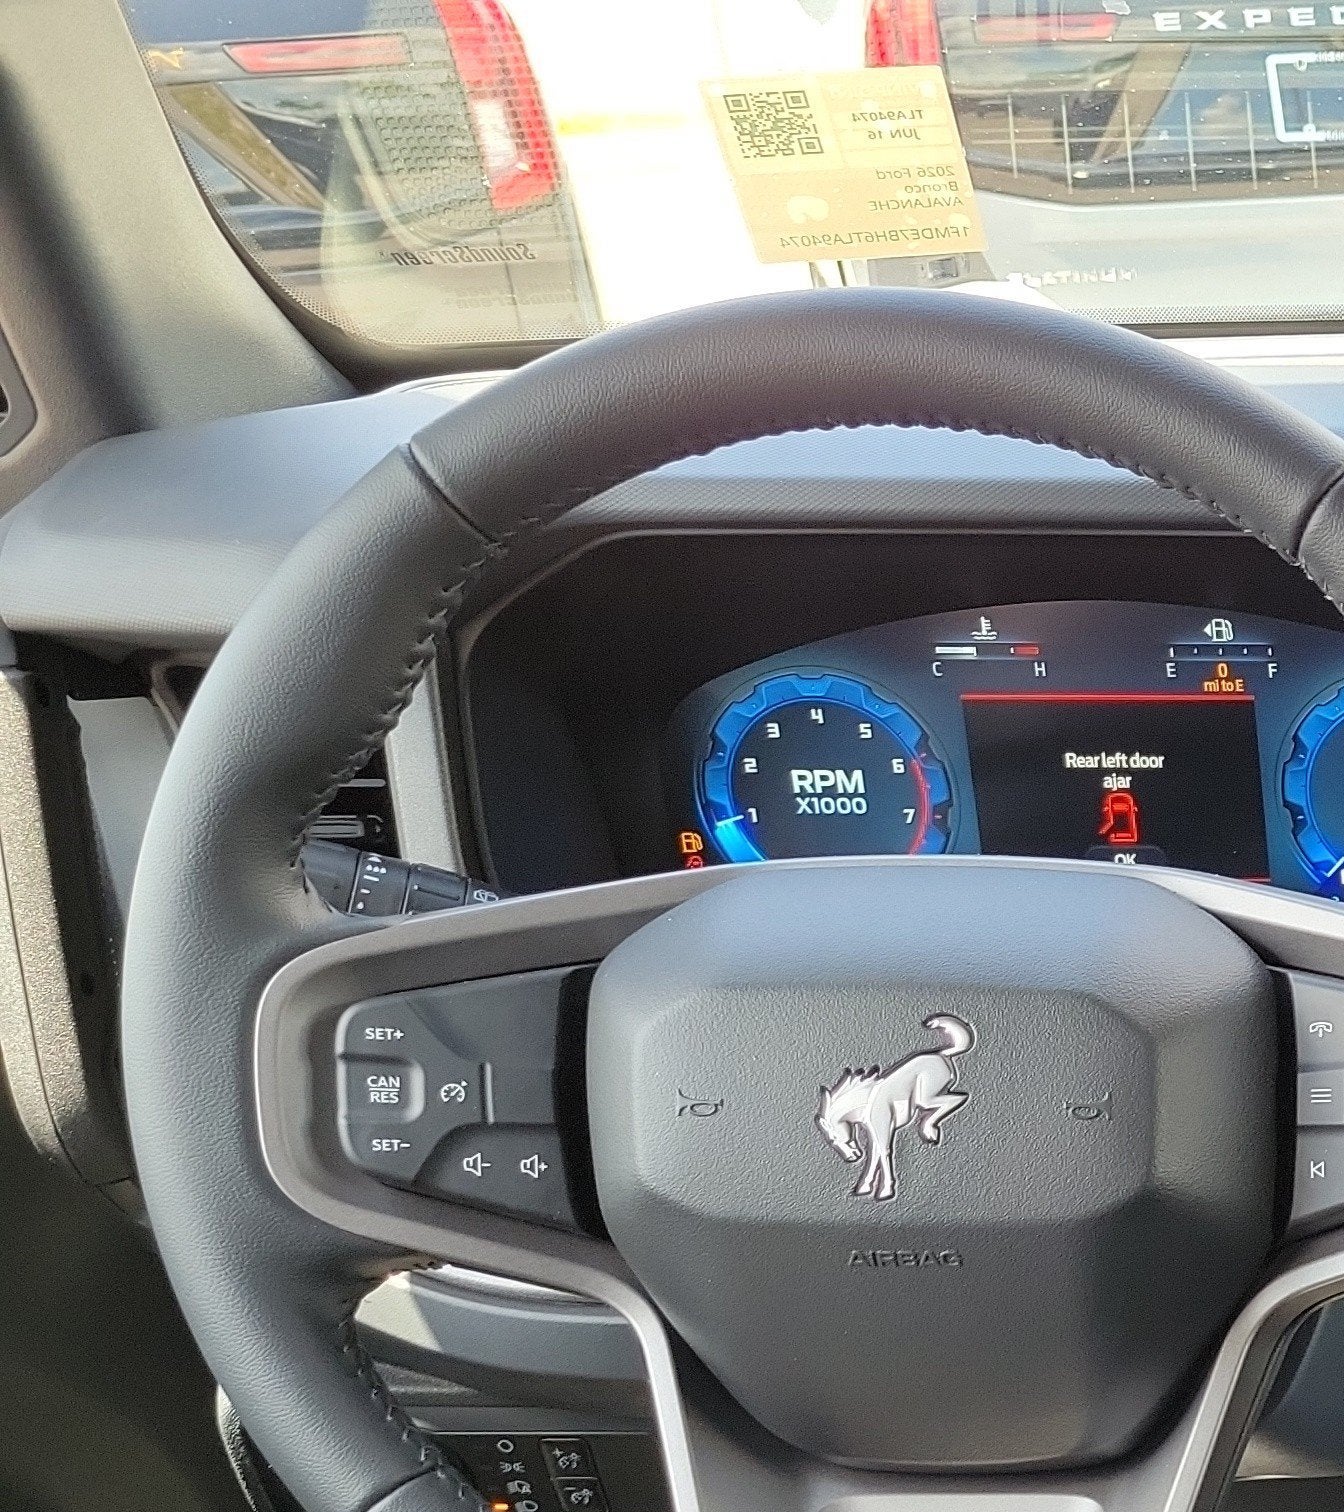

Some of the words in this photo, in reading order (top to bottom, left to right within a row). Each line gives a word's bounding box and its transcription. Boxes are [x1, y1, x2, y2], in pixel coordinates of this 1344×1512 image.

[932, 662, 943, 677] C
[1034, 663, 1047, 677] H
[1167, 663, 1177, 678] E
[1217, 663, 1228, 678] 0
[1268, 663, 1278, 678] F
[810, 708, 824, 724] 4
[766, 723, 781, 738] 3
[859, 724, 873, 738] 5
[742, 758, 758, 773] 2
[891, 758, 905, 773] 6
[1064, 752, 1100, 769] Rear
[1101, 751, 1128, 769] left
[1129, 751, 1165, 769] door
[790, 769, 866, 794] RPM
[1103, 773, 1132, 790] ajar
[796, 797, 868, 814] X1000
[748, 808, 759, 823] 1
[902, 808, 916, 823] 7
[365, 1027, 404, 1041] SET+
[367, 1076, 401, 1089] CAN
[370, 1091, 399, 1104] RES
[847, 1249, 964, 1268] AIRBAG
